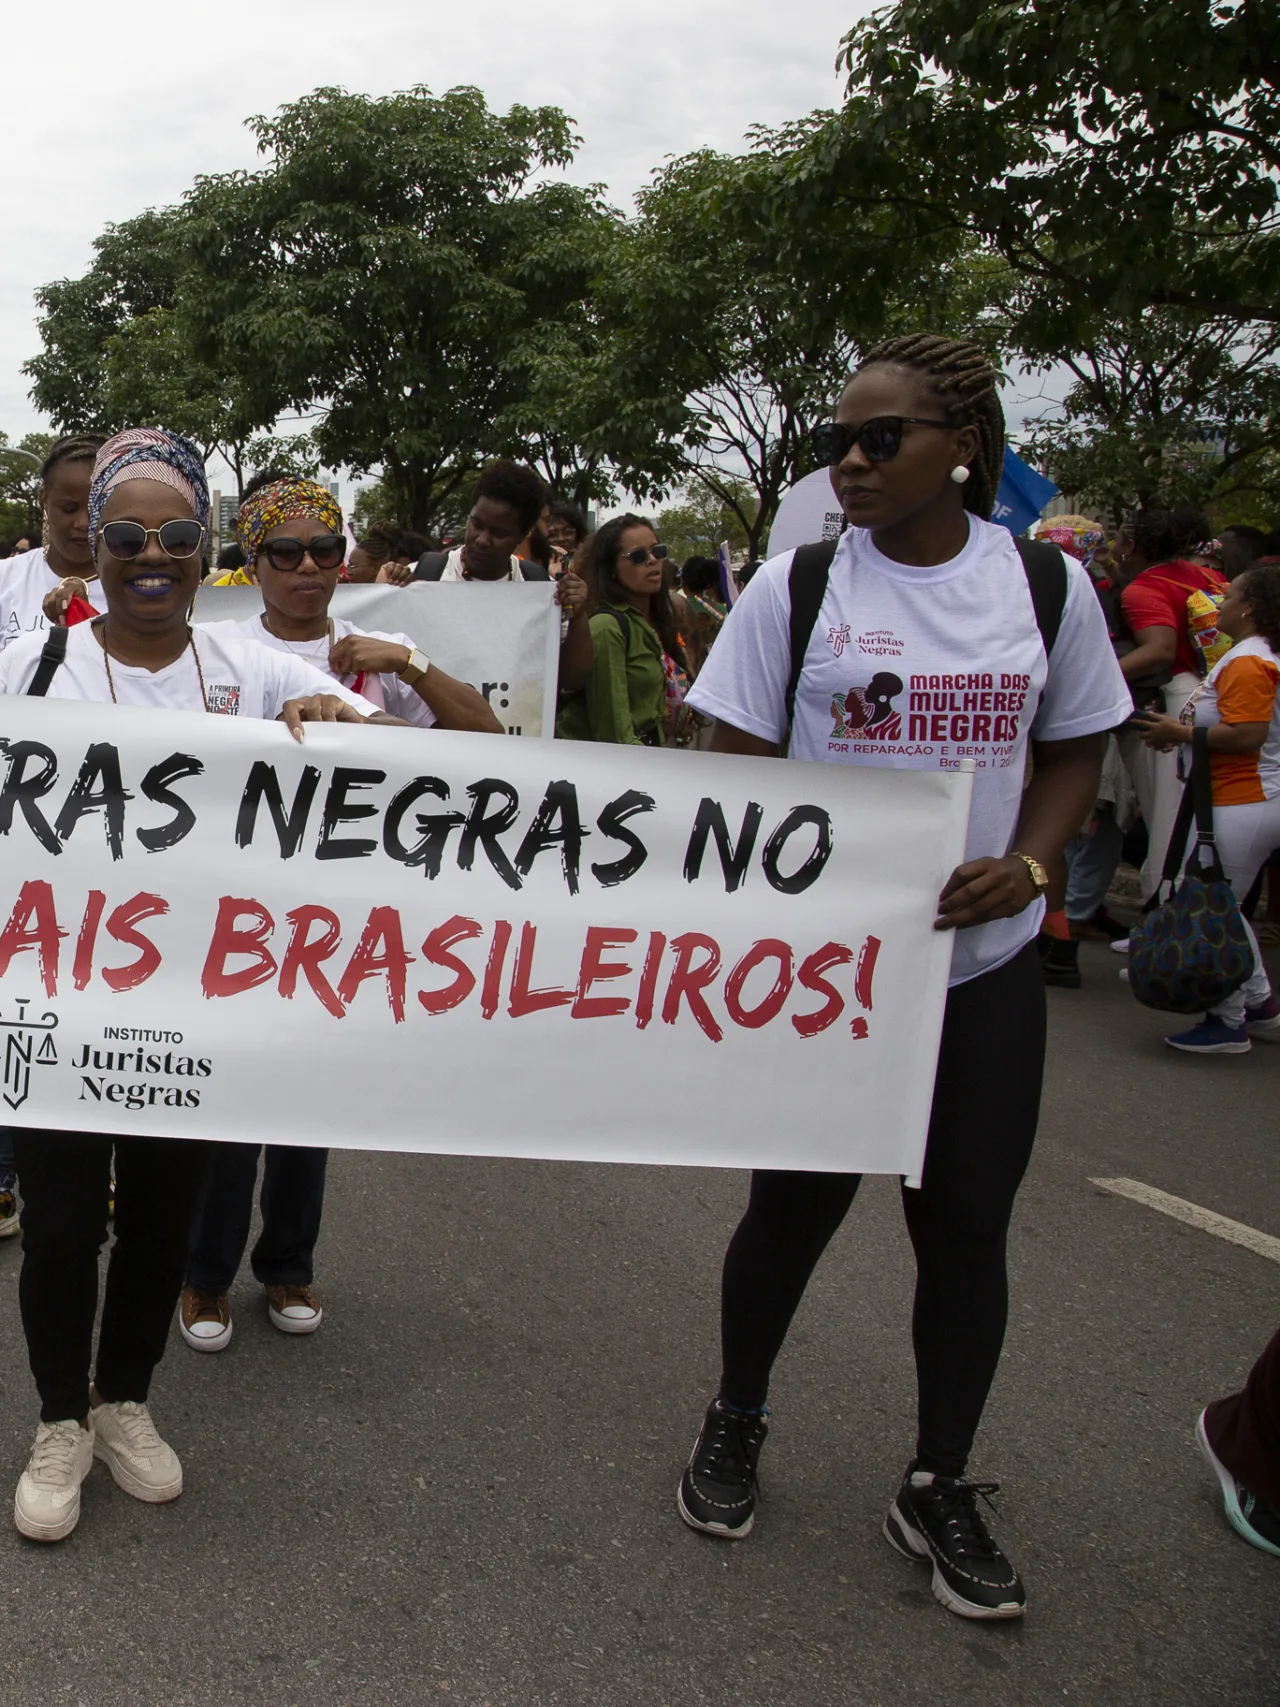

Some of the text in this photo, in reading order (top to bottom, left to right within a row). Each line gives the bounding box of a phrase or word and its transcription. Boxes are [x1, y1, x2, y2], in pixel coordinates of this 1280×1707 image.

[855, 635, 905, 647] Juristas
[858, 645, 902, 656] Negras
[910, 673, 1031, 690] MARCHA DAS
[208, 696, 240, 707] NEGRA
[909, 692, 1025, 712] MULHERES
[908, 714, 1019, 742] NEGRAS
[828, 742, 849, 752] POR
[853, 744, 934, 757] REPARAÇÃO
[940, 746, 949, 755] E
[957, 746, 985, 756] BEM
[235, 760, 658, 897] NEGRAS
[683, 797, 834, 895] NO
[201, 895, 883, 1043] BRASILEIROS!
[103, 1026, 184, 1044] INSTITUTO
[71, 1044, 212, 1077] Juristas
[77, 1076, 201, 1110] Negras
